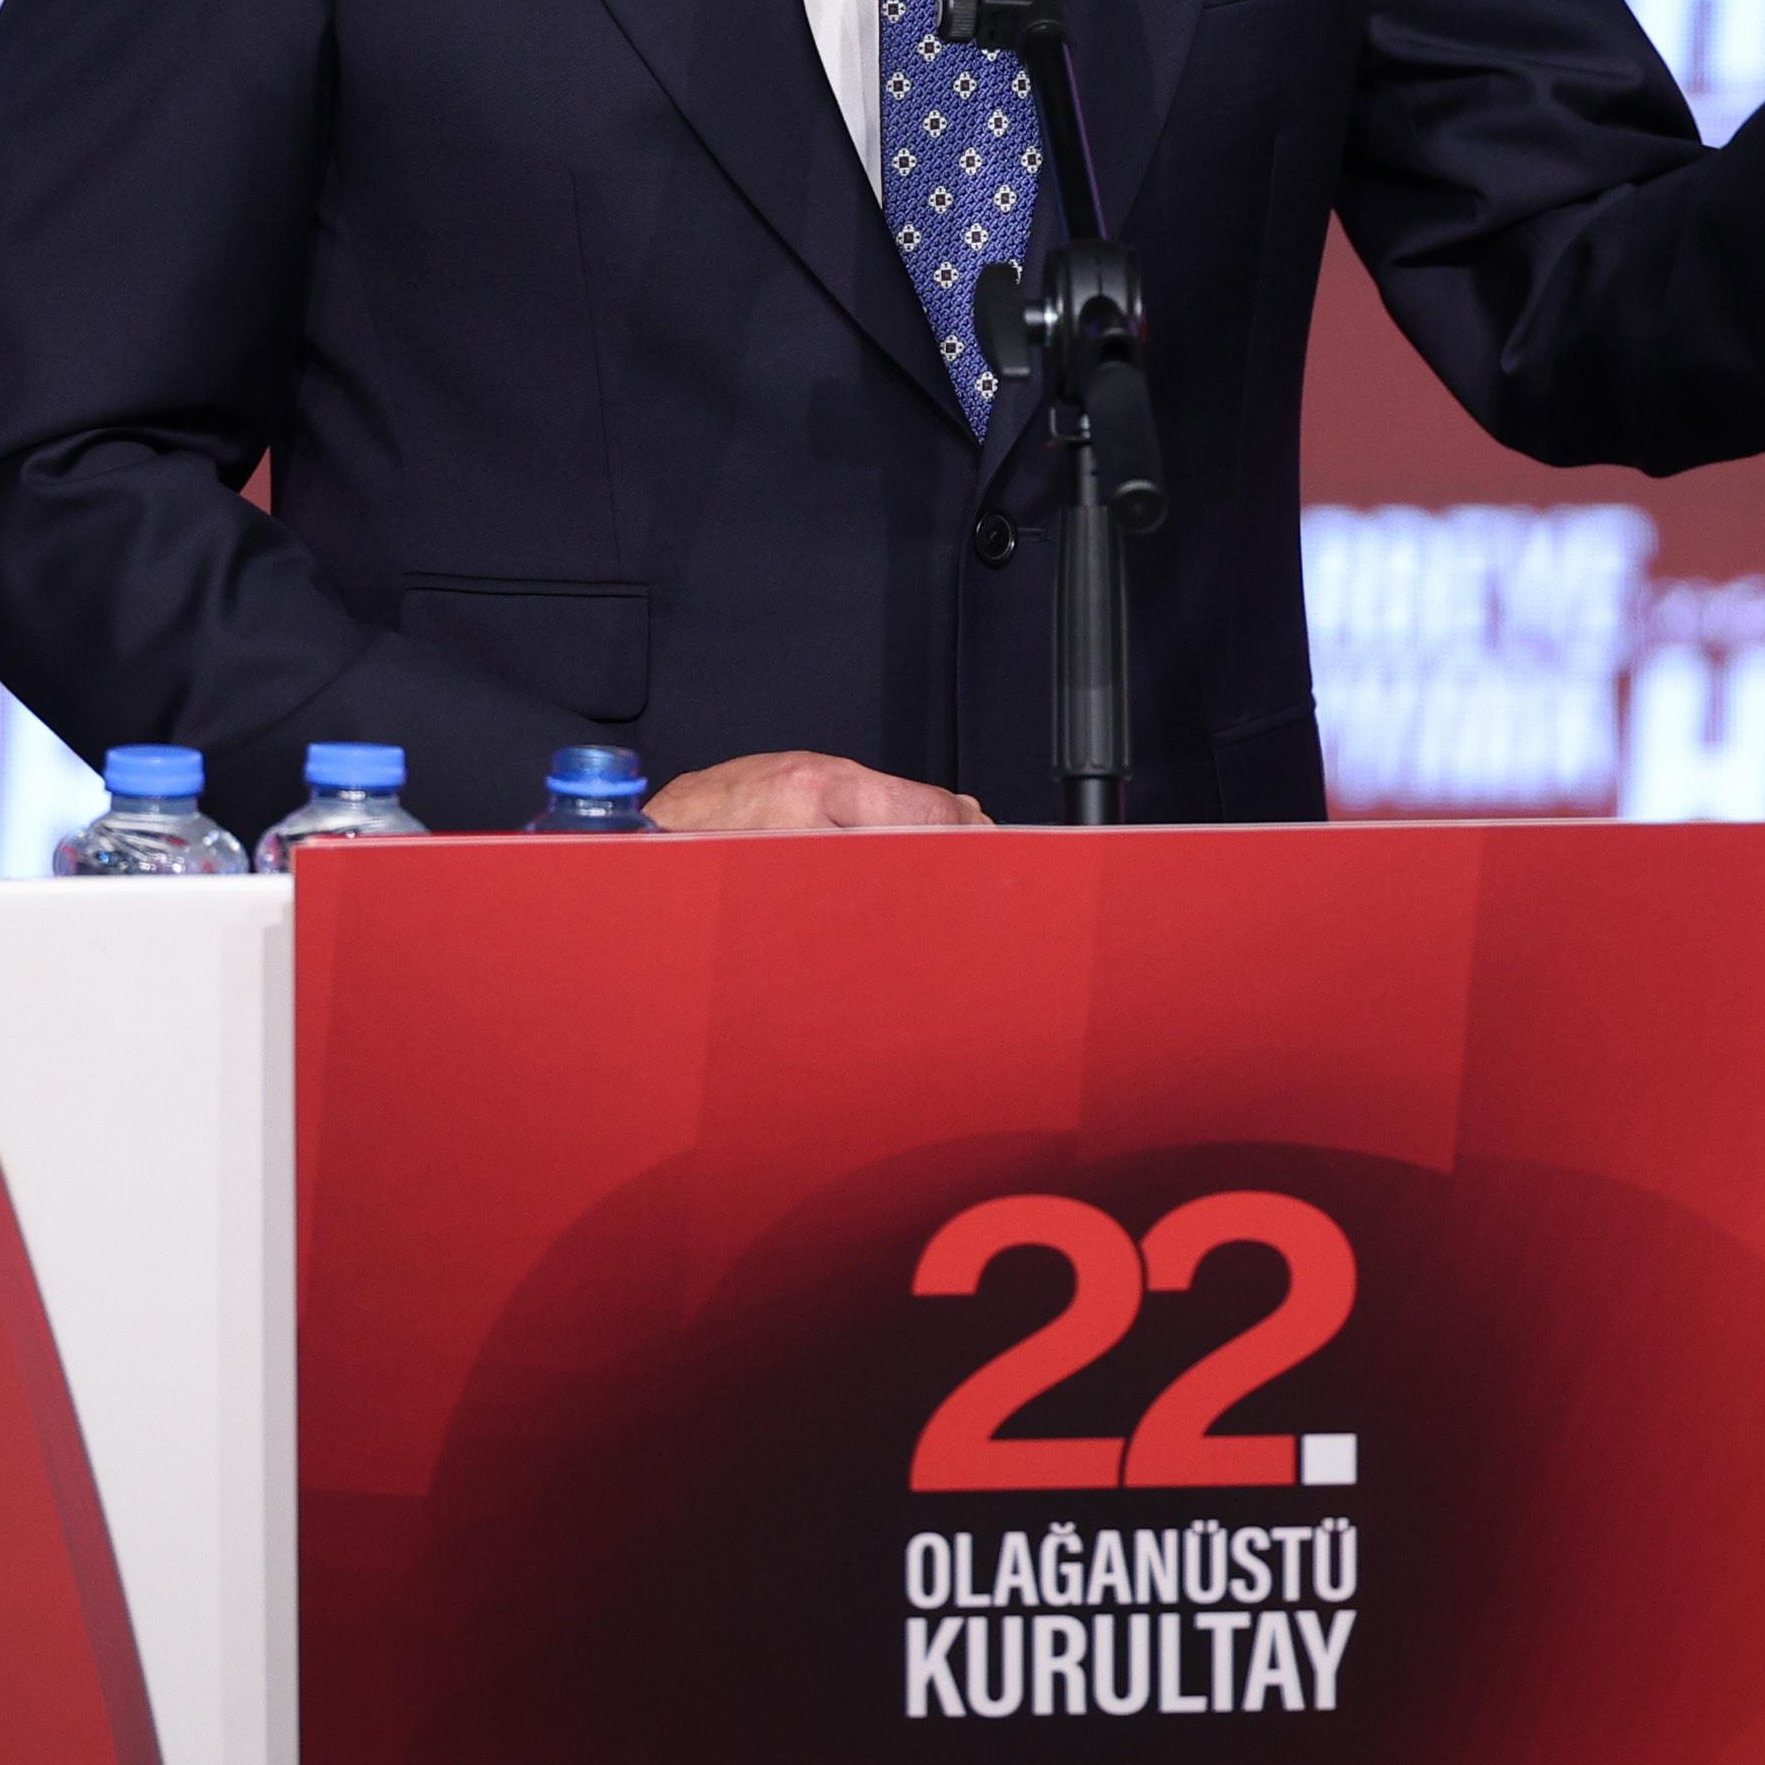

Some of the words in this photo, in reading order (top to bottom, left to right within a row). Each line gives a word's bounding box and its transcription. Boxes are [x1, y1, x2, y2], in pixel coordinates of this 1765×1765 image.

[909, 1189, 1358, 1493] 22.
[905, 1517, 1358, 1608] OLAĞANÜSTÜ
[905, 1609, 1358, 1719] KURULTAY
